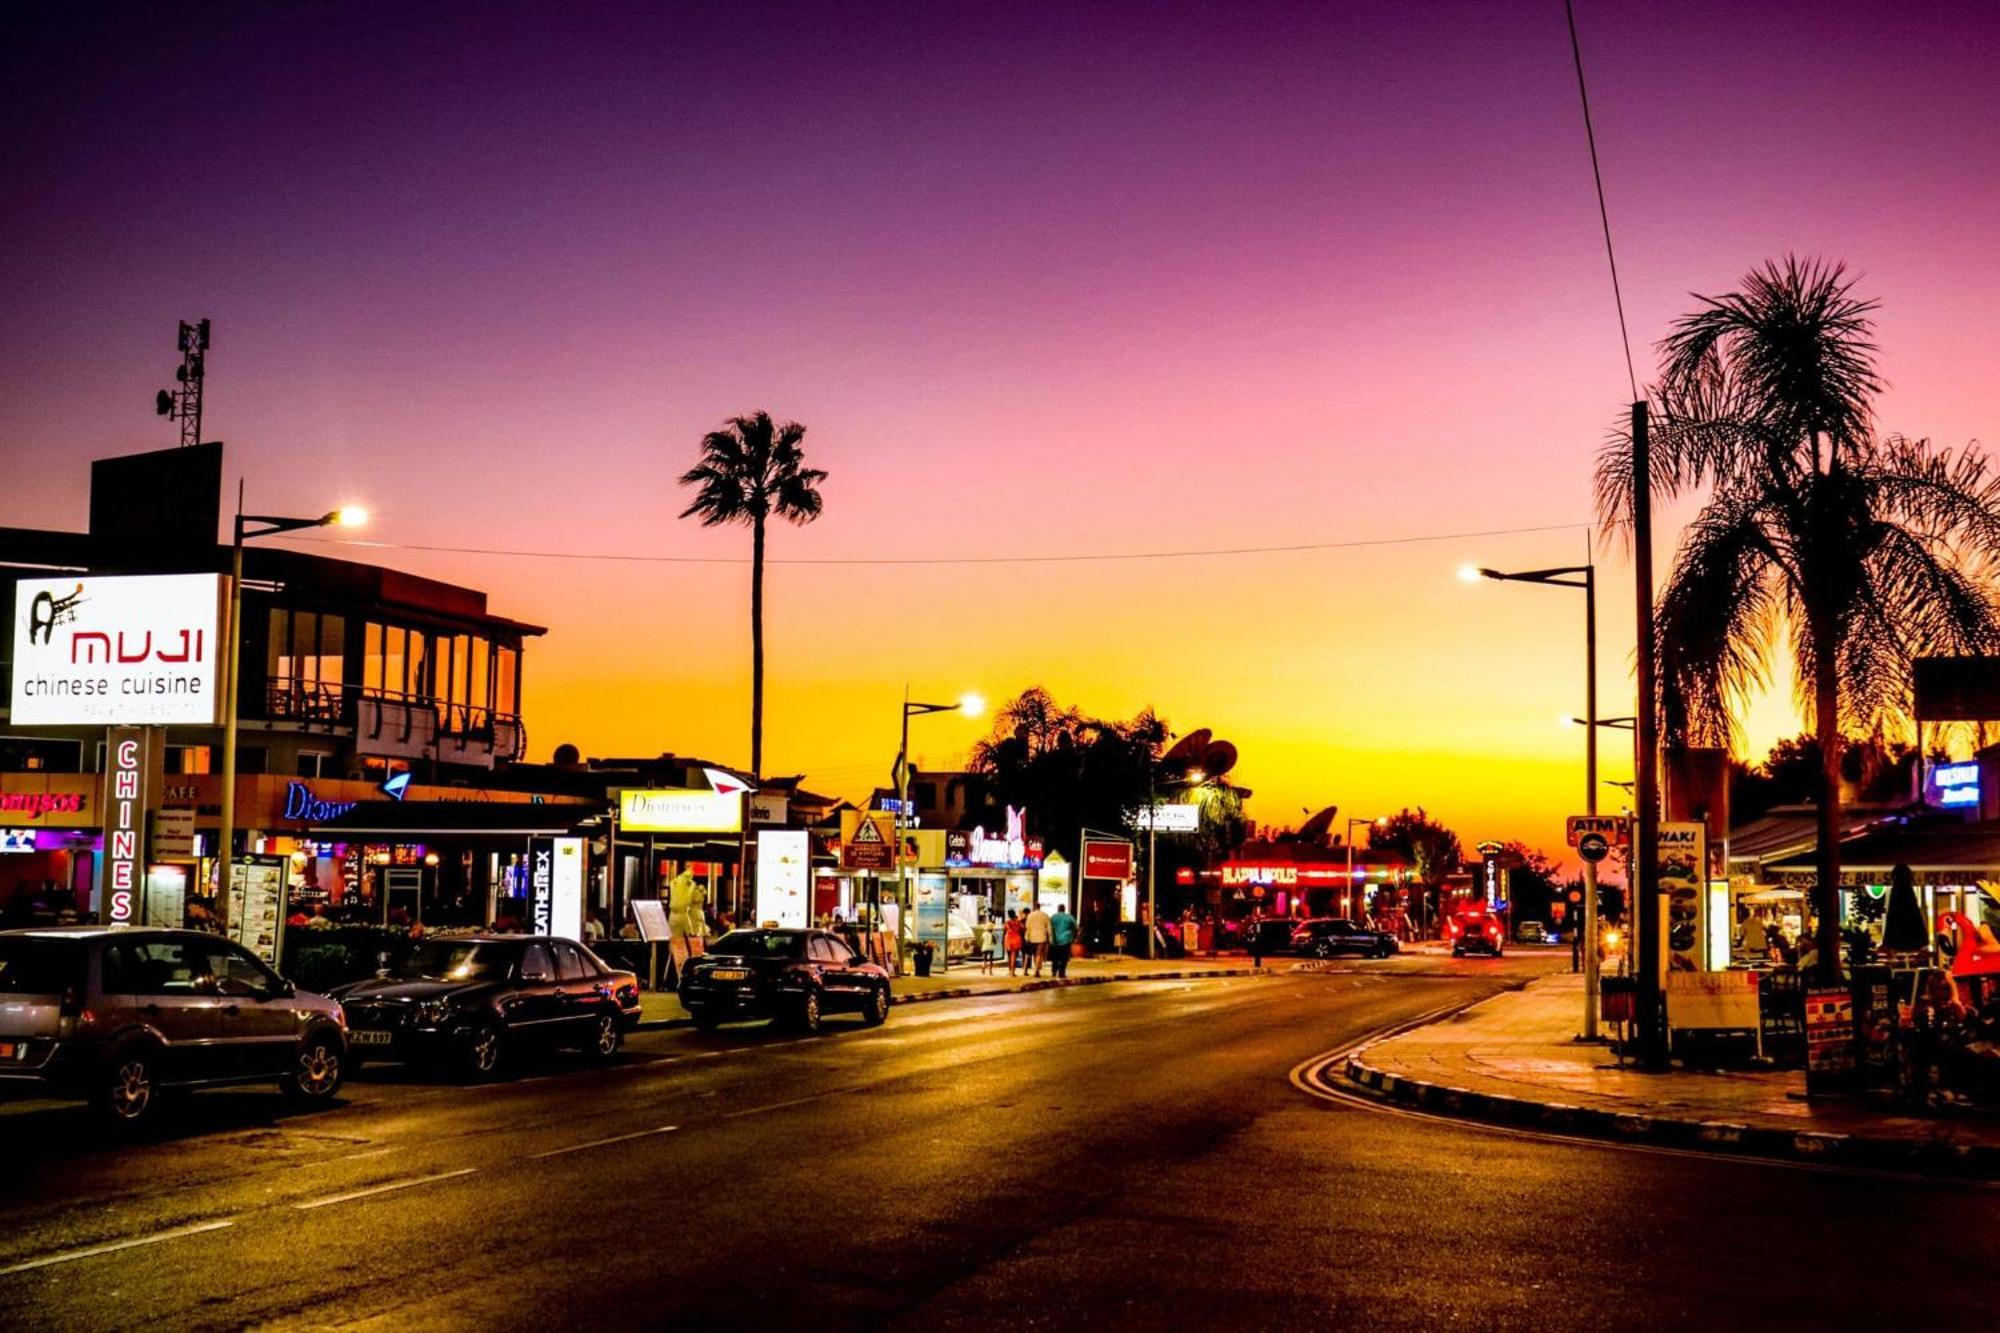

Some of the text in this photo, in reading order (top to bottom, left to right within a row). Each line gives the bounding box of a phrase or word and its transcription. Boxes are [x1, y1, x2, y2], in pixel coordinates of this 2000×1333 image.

[24, 672, 202, 696] chinese cuisine
[110, 740, 138, 928] CHINES
[1574, 819, 1614, 833] ATM
[533, 850, 550, 936] EATHEREX
